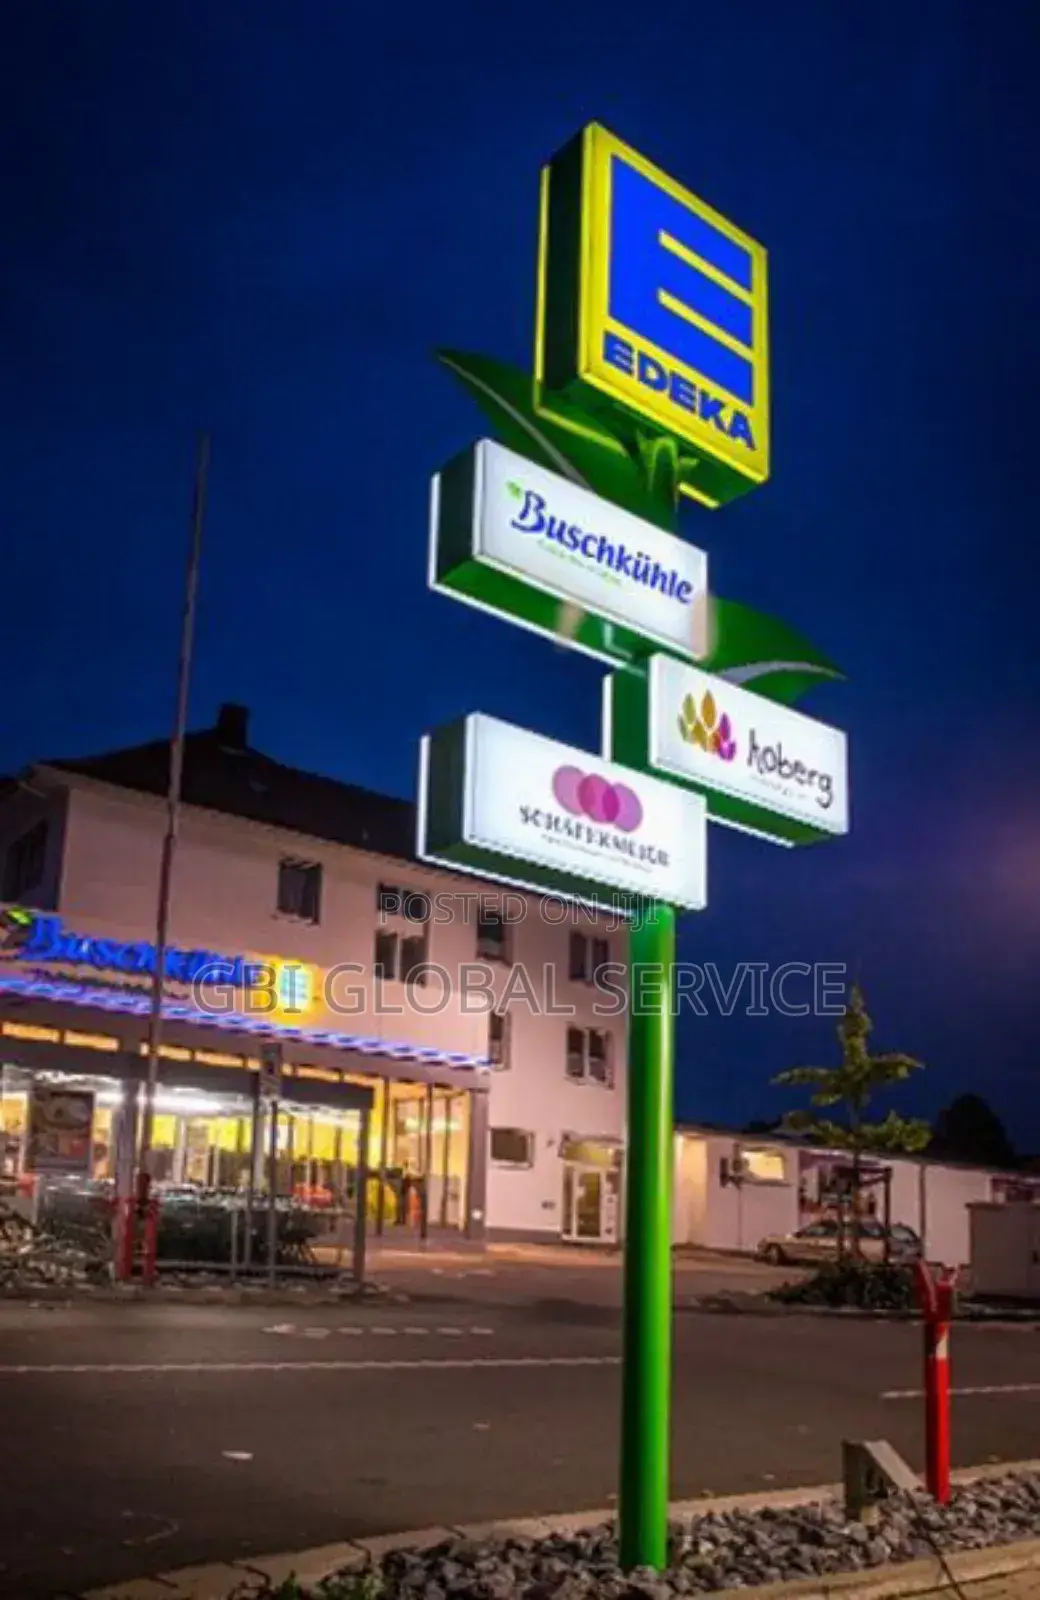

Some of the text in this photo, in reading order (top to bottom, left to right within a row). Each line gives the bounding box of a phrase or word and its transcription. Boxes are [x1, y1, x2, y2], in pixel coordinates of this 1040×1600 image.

[608, 154, 754, 407] E
[602, 330, 755, 450] EDEKA
[510, 490, 692, 604] Buschkühle
[747, 728, 832, 809] hoberg
